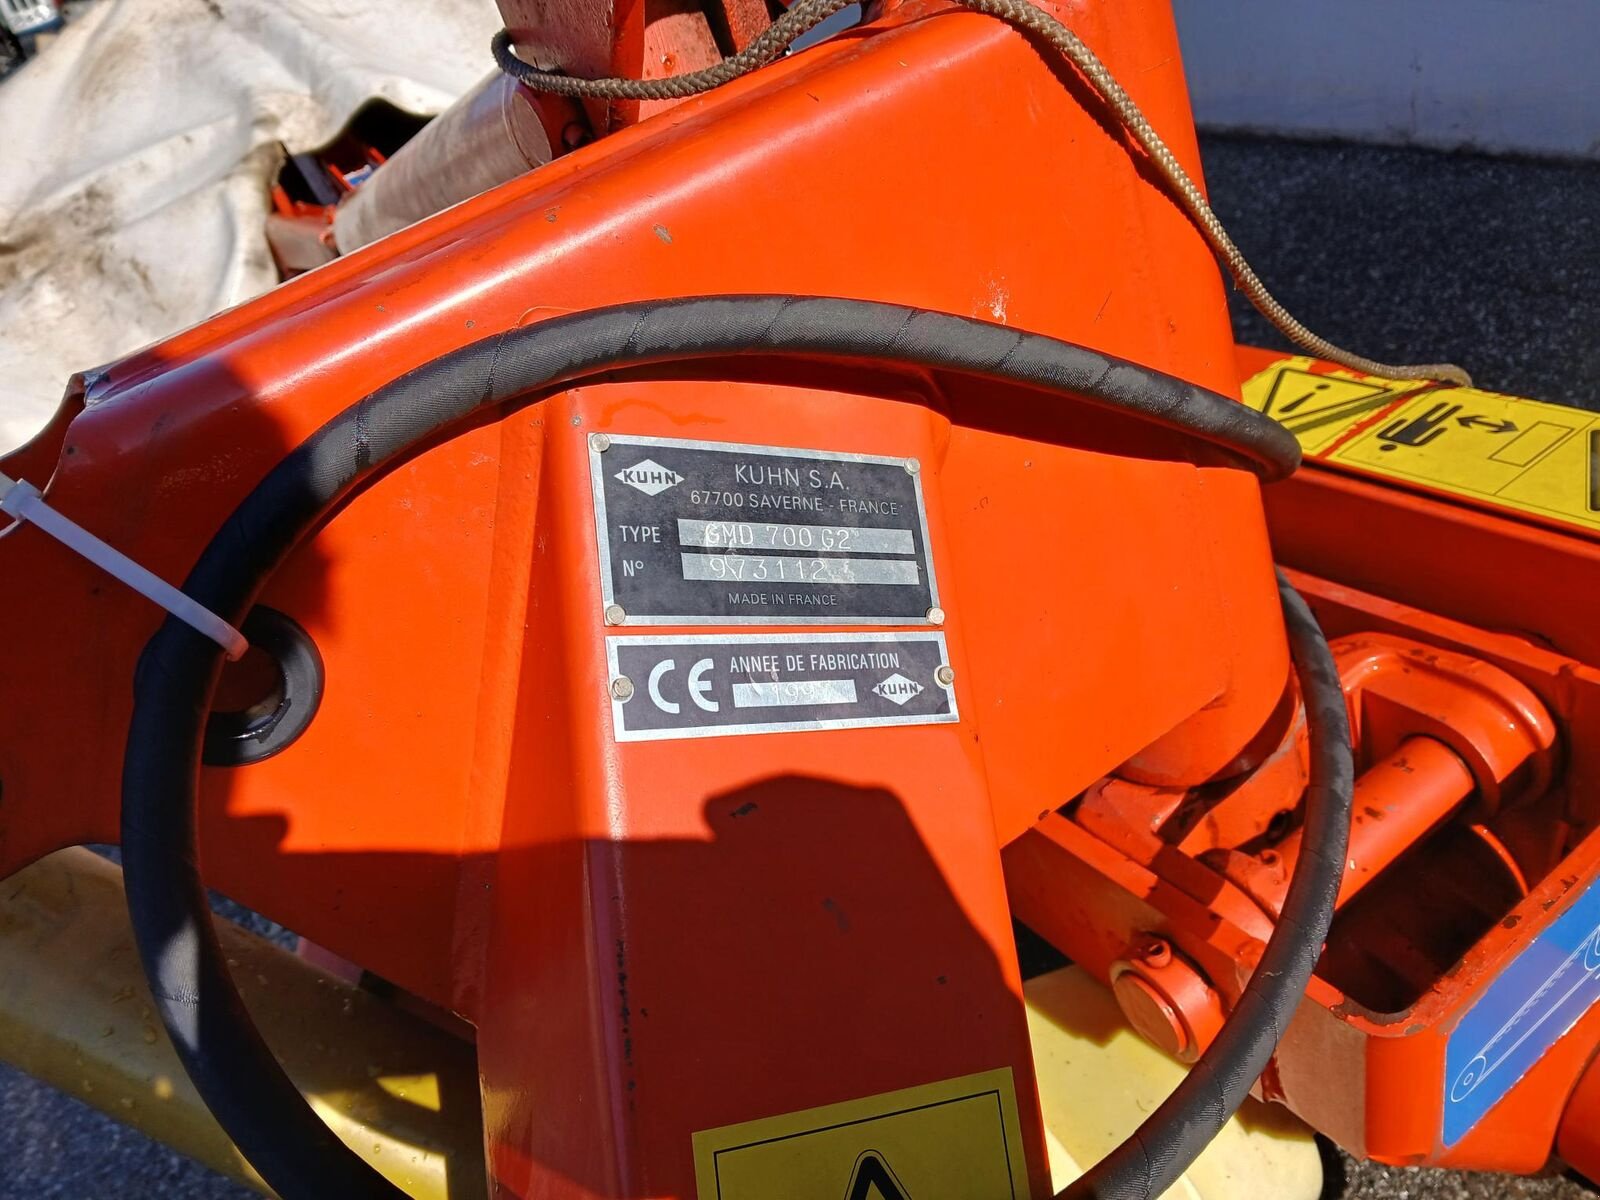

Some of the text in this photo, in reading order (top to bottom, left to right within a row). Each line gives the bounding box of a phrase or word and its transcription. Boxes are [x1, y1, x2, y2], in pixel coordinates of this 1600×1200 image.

[623, 470, 676, 485] KUHN
[735, 464, 849, 490] KUHN S.A.
[690, 490, 744, 507] 67700
[750, 493, 824, 512] SAVERNE
[839, 499, 899, 515] FRANCE
[619, 523, 851, 550] TYPE GMD 700 G2
[728, 592, 837, 605] MADE IN FRANCE
[730, 652, 900, 673] ANNEE DE FABRICATION
[648, 658, 720, 714] CE
[877, 682, 919, 696] KUHN
